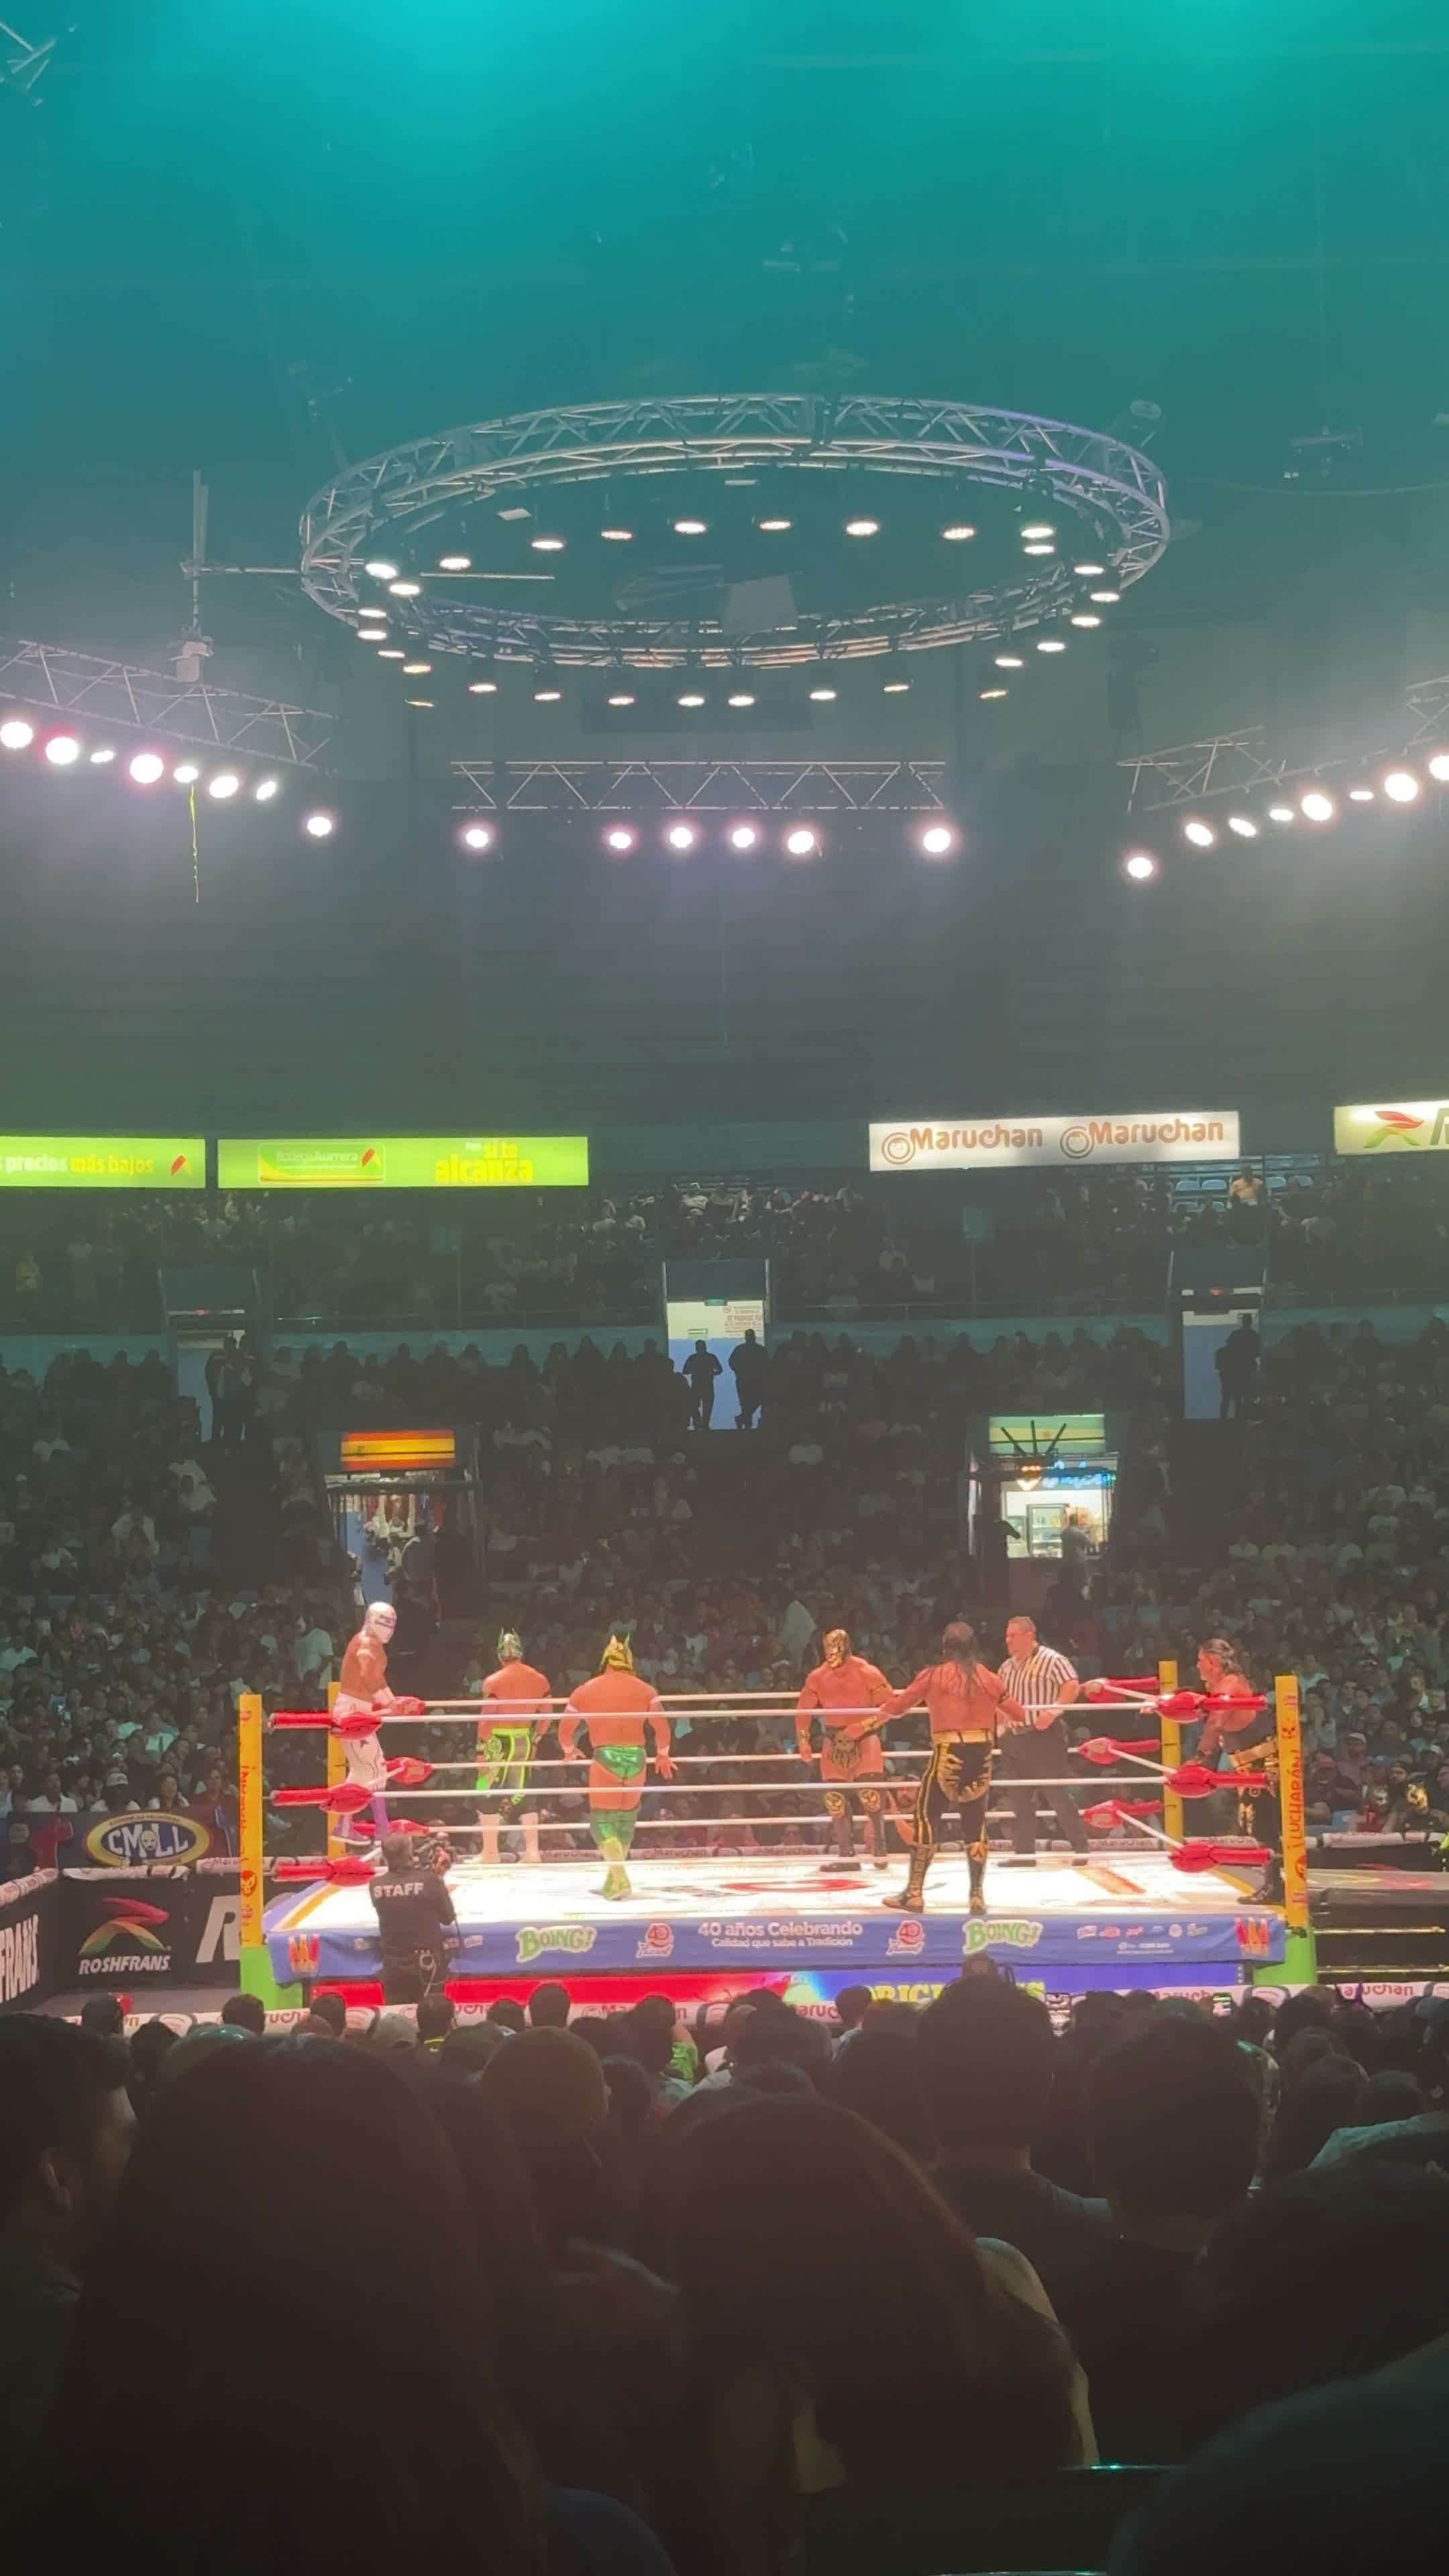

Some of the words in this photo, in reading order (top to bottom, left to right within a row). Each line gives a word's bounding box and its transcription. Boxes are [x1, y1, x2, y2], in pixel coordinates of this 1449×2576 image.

[910, 1124, 1042, 1150] Maruchan
[1089, 1118, 1224, 1145] Maruchan
[5, 1154, 68, 1173] precios
[108, 1155, 154, 1175] bajos
[435, 1153, 533, 1183] alcanza
[107, 1823, 189, 1858] CMLL
[373, 1882, 425, 1898] STAFF
[698, 1922, 721, 1936] 40
[726, 1923, 765, 1936] años
[767, 1921, 863, 1936] Celebrando
[712, 1938, 750, 1947] Calidad
[752, 1939, 770, 1948] que
[78, 1955, 170, 1975] ROSHFRANS
